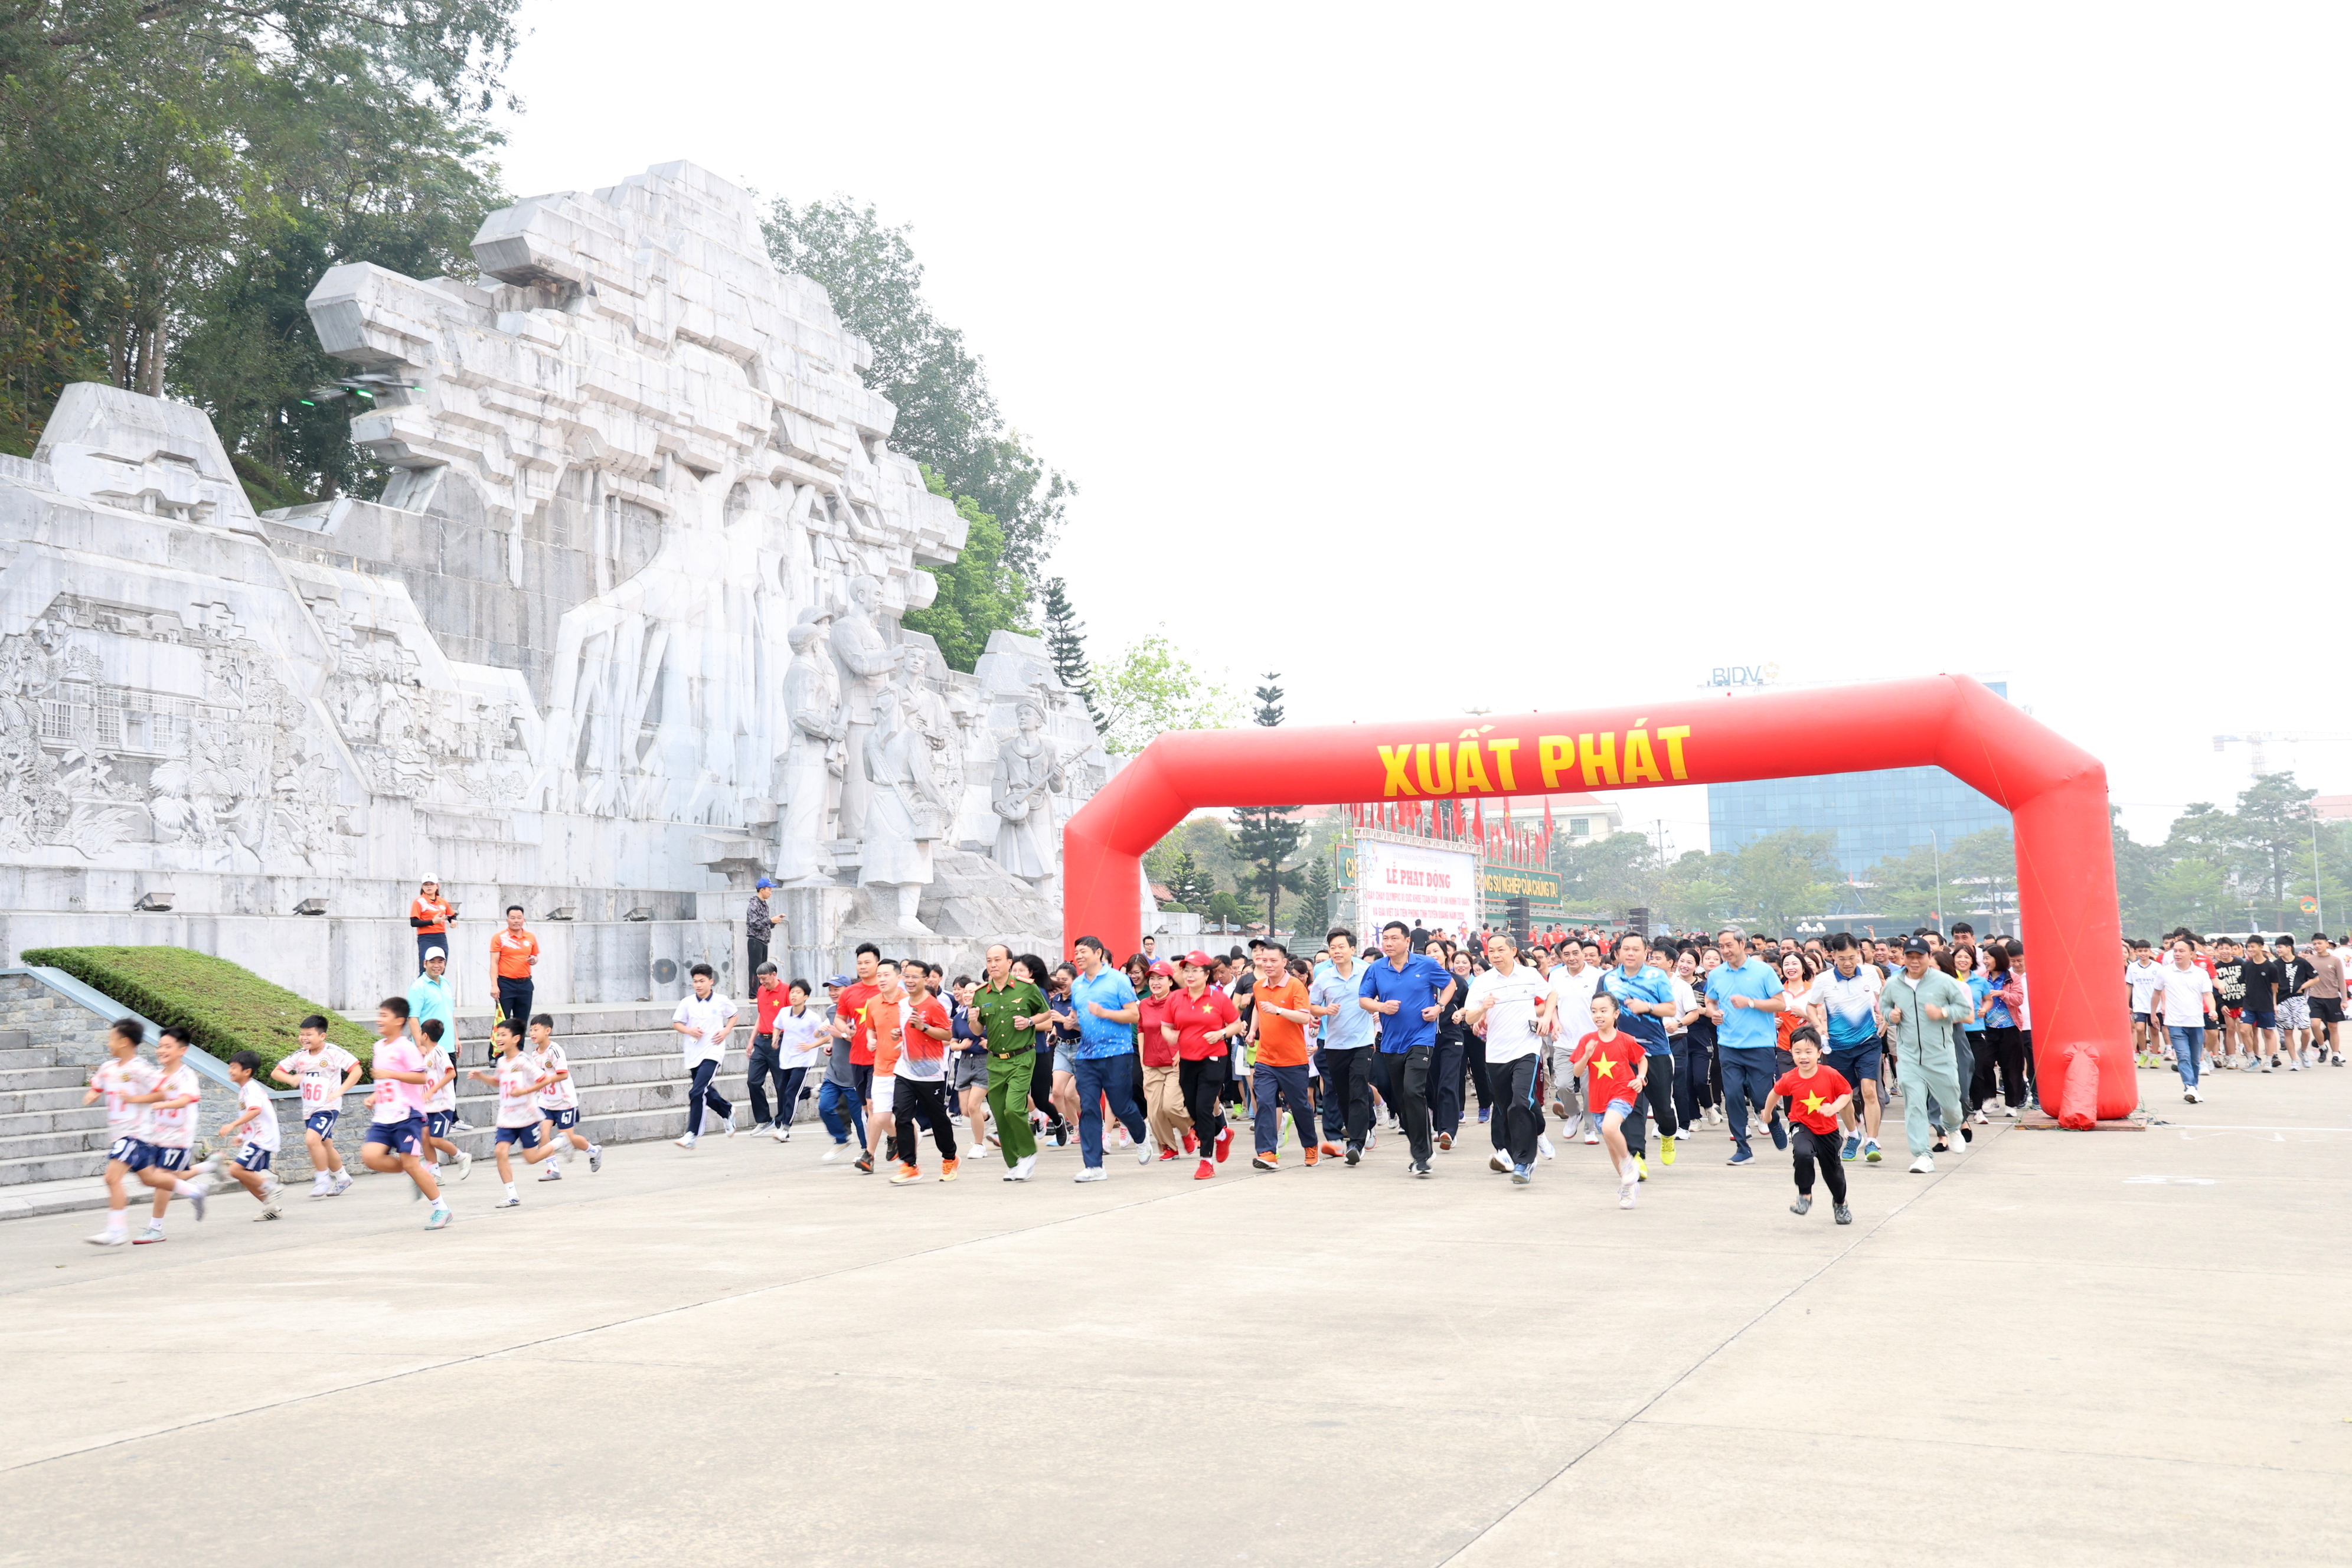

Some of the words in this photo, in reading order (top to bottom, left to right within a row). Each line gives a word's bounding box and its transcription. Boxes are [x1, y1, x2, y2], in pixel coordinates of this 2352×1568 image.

[1713, 665, 1762, 684] BIDV
[1377, 724, 1519, 797] XUẤT
[1538, 717, 1690, 788] PHÁT
[1386, 861, 1397, 884] LỄ
[1400, 867, 1424, 887] PHÁT
[1426, 870, 1451, 891] ĐỘNG
[1493, 874, 1501, 897] SỰ
[1502, 874, 1521, 898] NGHIỆP
[1521, 873, 1532, 896] CỦA
[1532, 877, 1549, 897] CHÚNG
[1386, 892, 1401, 901] OLYMPIC
[2216, 965, 2242, 978] TAKE
[2226, 975, 2238, 984] ME
[316, 1116, 328, 1130] 3
[561, 1111, 573, 1125] 47
[433, 1121, 443, 1134] 7
[531, 1125, 541, 1142] 5
[164, 1149, 181, 1167] 17
